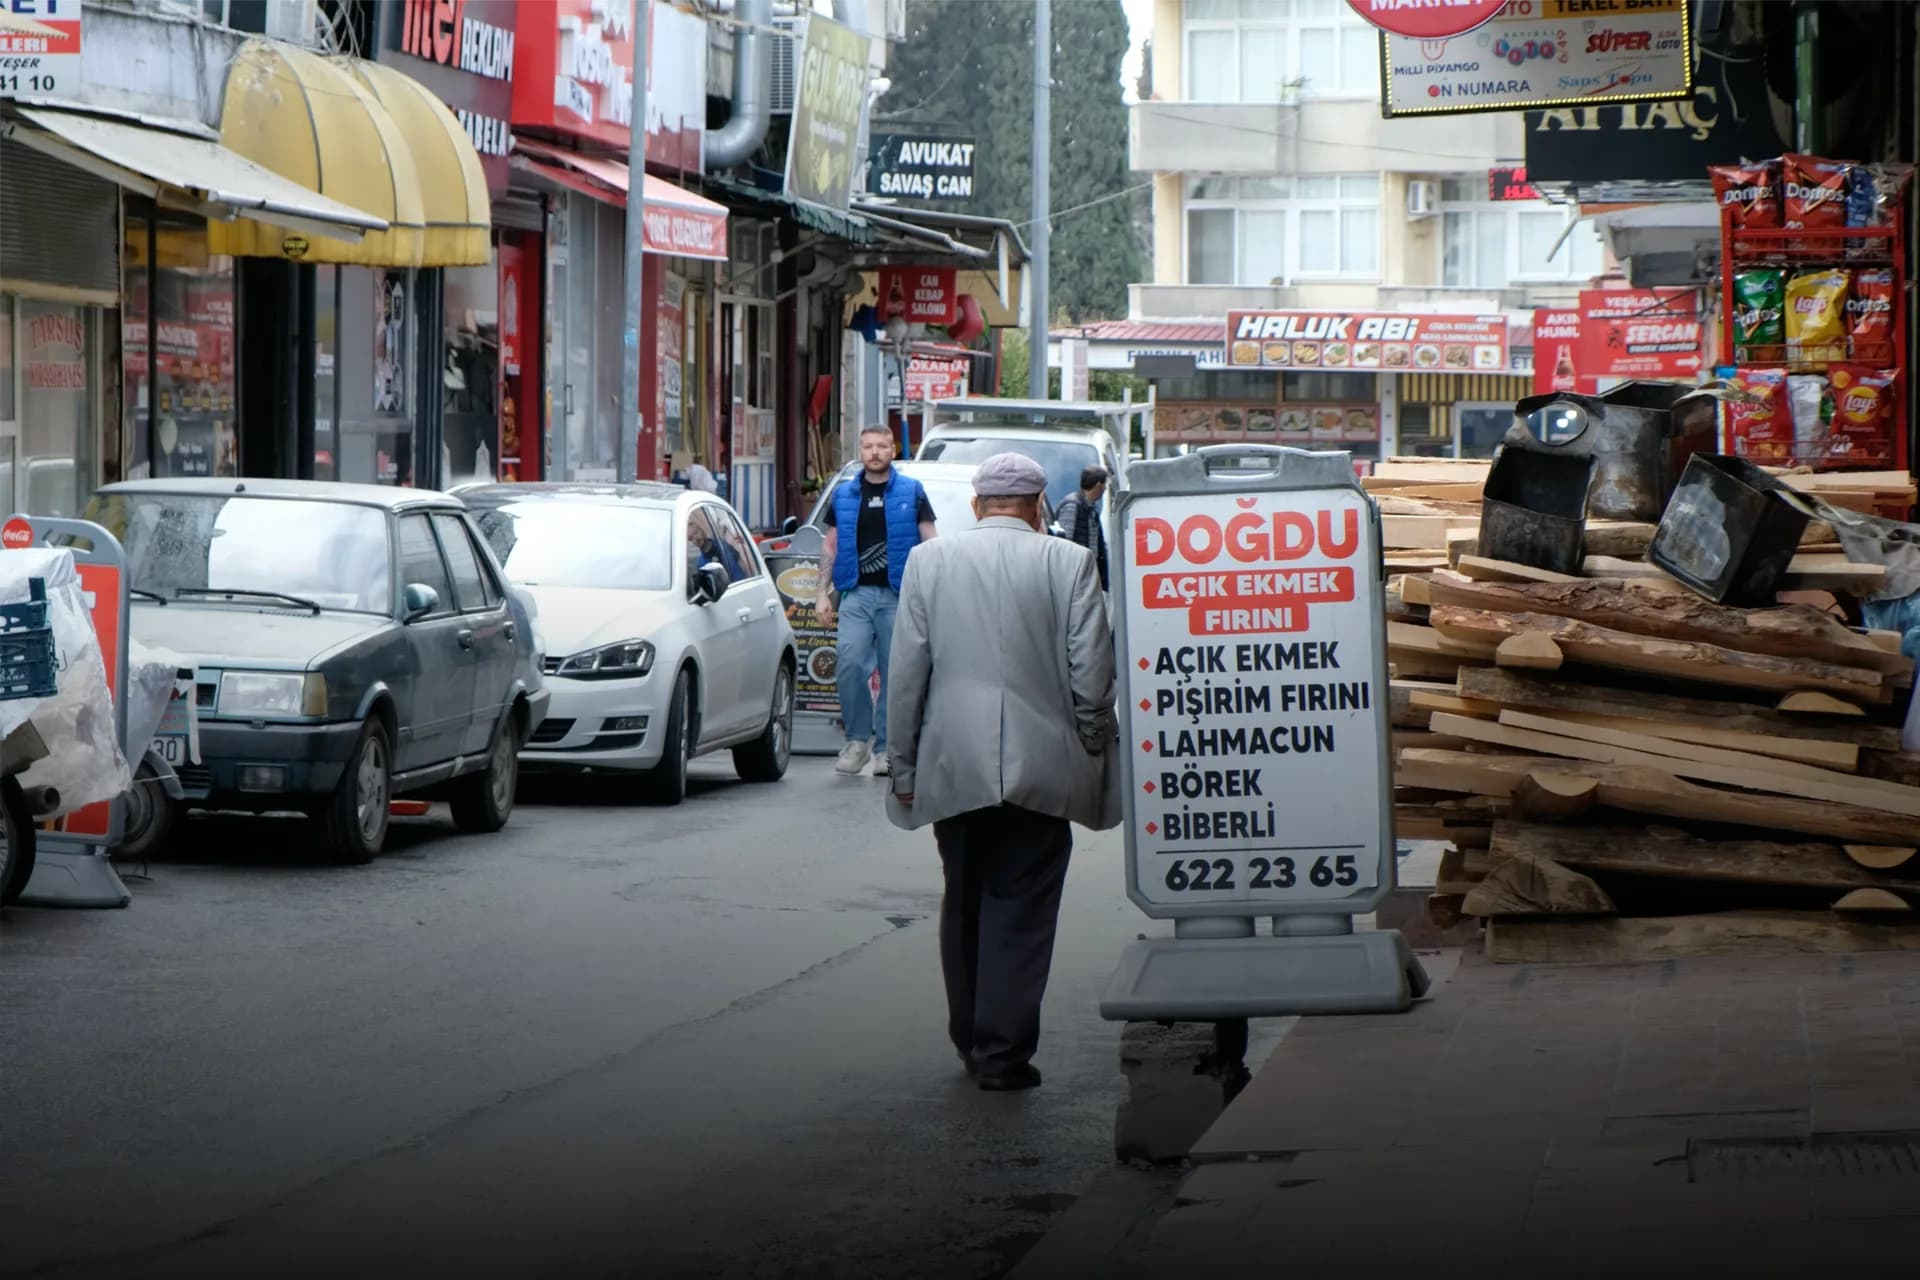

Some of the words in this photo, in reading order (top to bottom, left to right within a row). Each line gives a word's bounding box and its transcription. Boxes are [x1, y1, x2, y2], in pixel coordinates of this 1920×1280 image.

[460, 17, 515, 83] REKLAM
[1585, 29, 1652, 53] SÜPER
[30, 75, 55, 91] 10
[1458, 79, 1532, 97] NUMARA
[898, 141, 975, 167] AVUKAT
[880, 172, 934, 199] SAVAŞ
[937, 175, 972, 196] CAN
[1786, 182, 1846, 204] Doritos
[915, 289, 944, 301] KEBAP
[911, 302, 946, 315] SALONU
[1236, 316, 1352, 340] HALUK
[1625, 323, 1700, 344] SERCAN
[1135, 497, 1359, 566] DOĞDU
[1156, 574, 1227, 604] AÇIK
[1237, 570, 1340, 597] EKMEK
[1205, 607, 1293, 631] FIRINI
[1155, 644, 1226, 682] AÇIK
[1236, 641, 1340, 672] EKMEK
[1157, 678, 1270, 725] PİŞİRİM
[1281, 681, 1369, 712] FIRINI
[1158, 725, 1335, 758] LAHMACUN
[1161, 763, 1263, 800] BÖREK
[1163, 801, 1276, 841] BİBERLİ
[1165, 858, 1235, 892] 622
[1248, 856, 1297, 889] 23
[1309, 855, 1359, 887] 65
